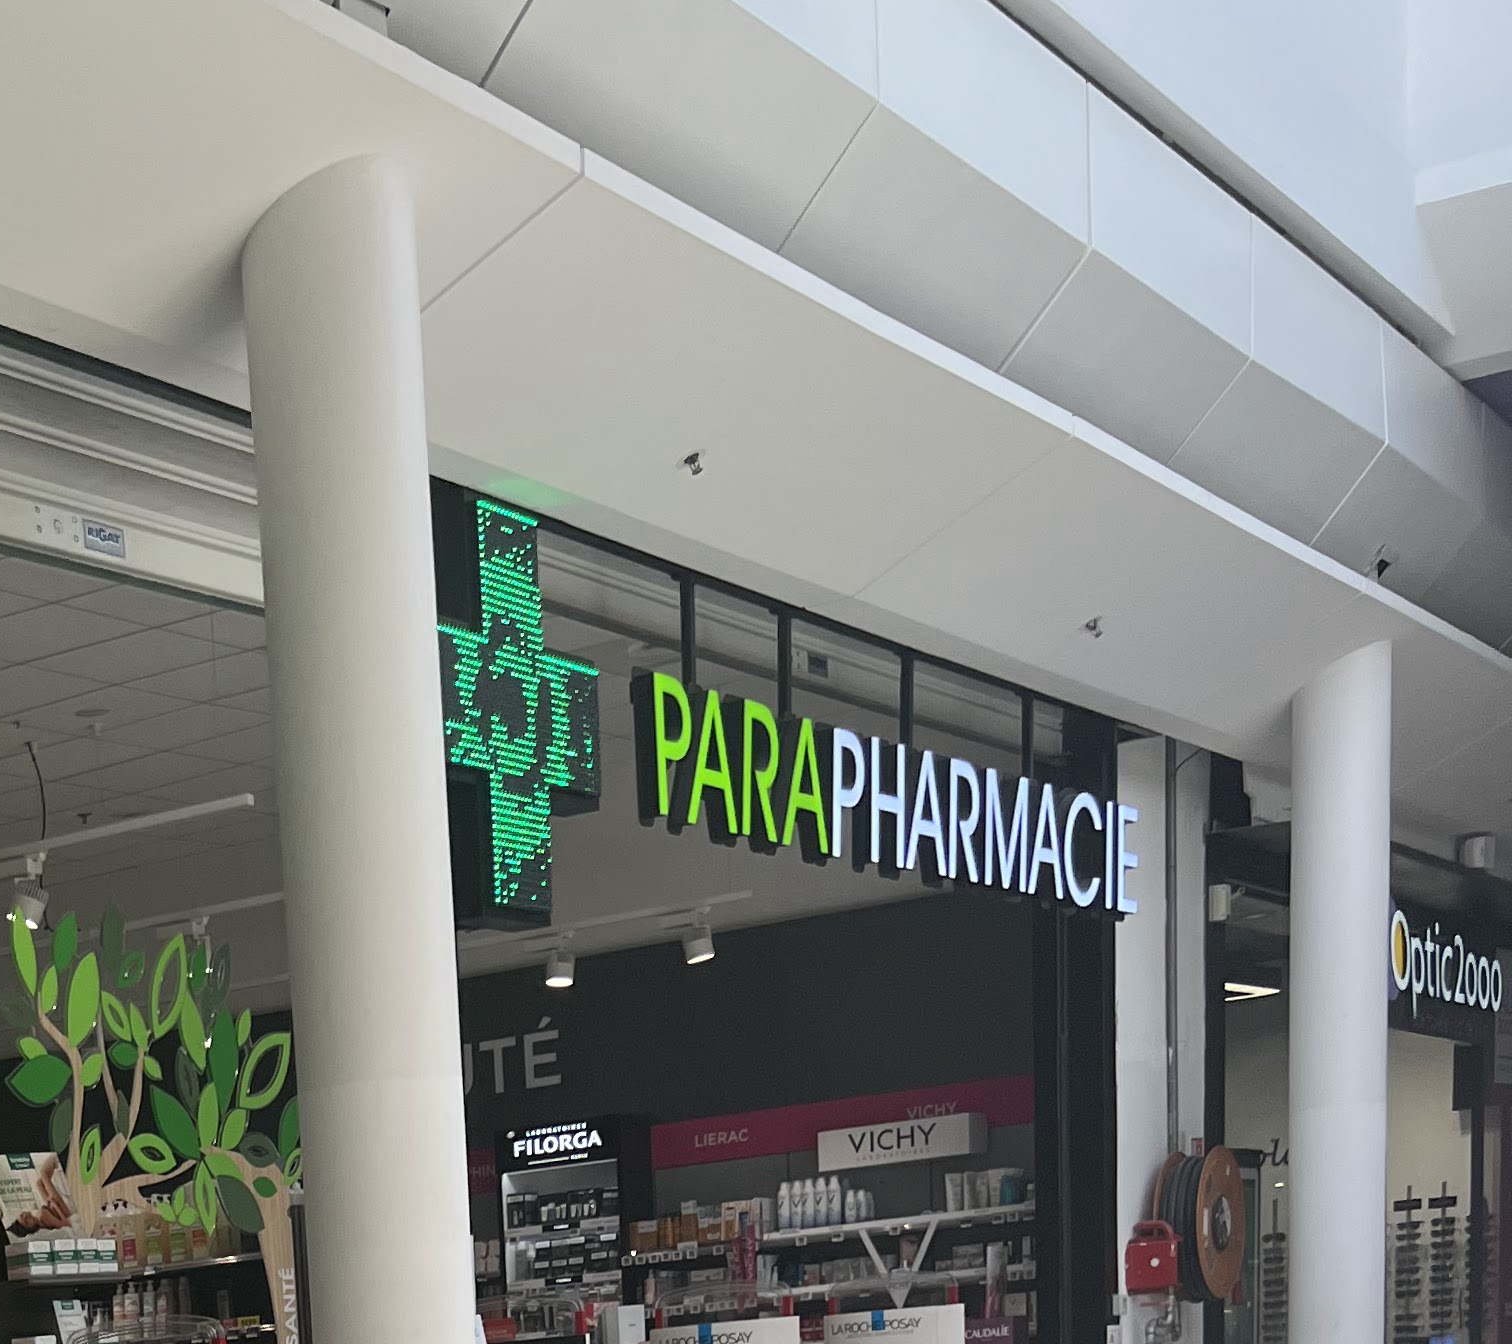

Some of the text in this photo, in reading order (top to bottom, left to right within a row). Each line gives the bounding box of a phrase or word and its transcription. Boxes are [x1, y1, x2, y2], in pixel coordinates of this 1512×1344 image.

[653, 672, 1138, 915] PARAPHARMACIE
[906, 1101, 957, 1119] VICHY
[513, 1129, 603, 1159] FILORGA
[694, 1128, 749, 1149] LIERAC
[848, 1122, 937, 1154] VICHY
